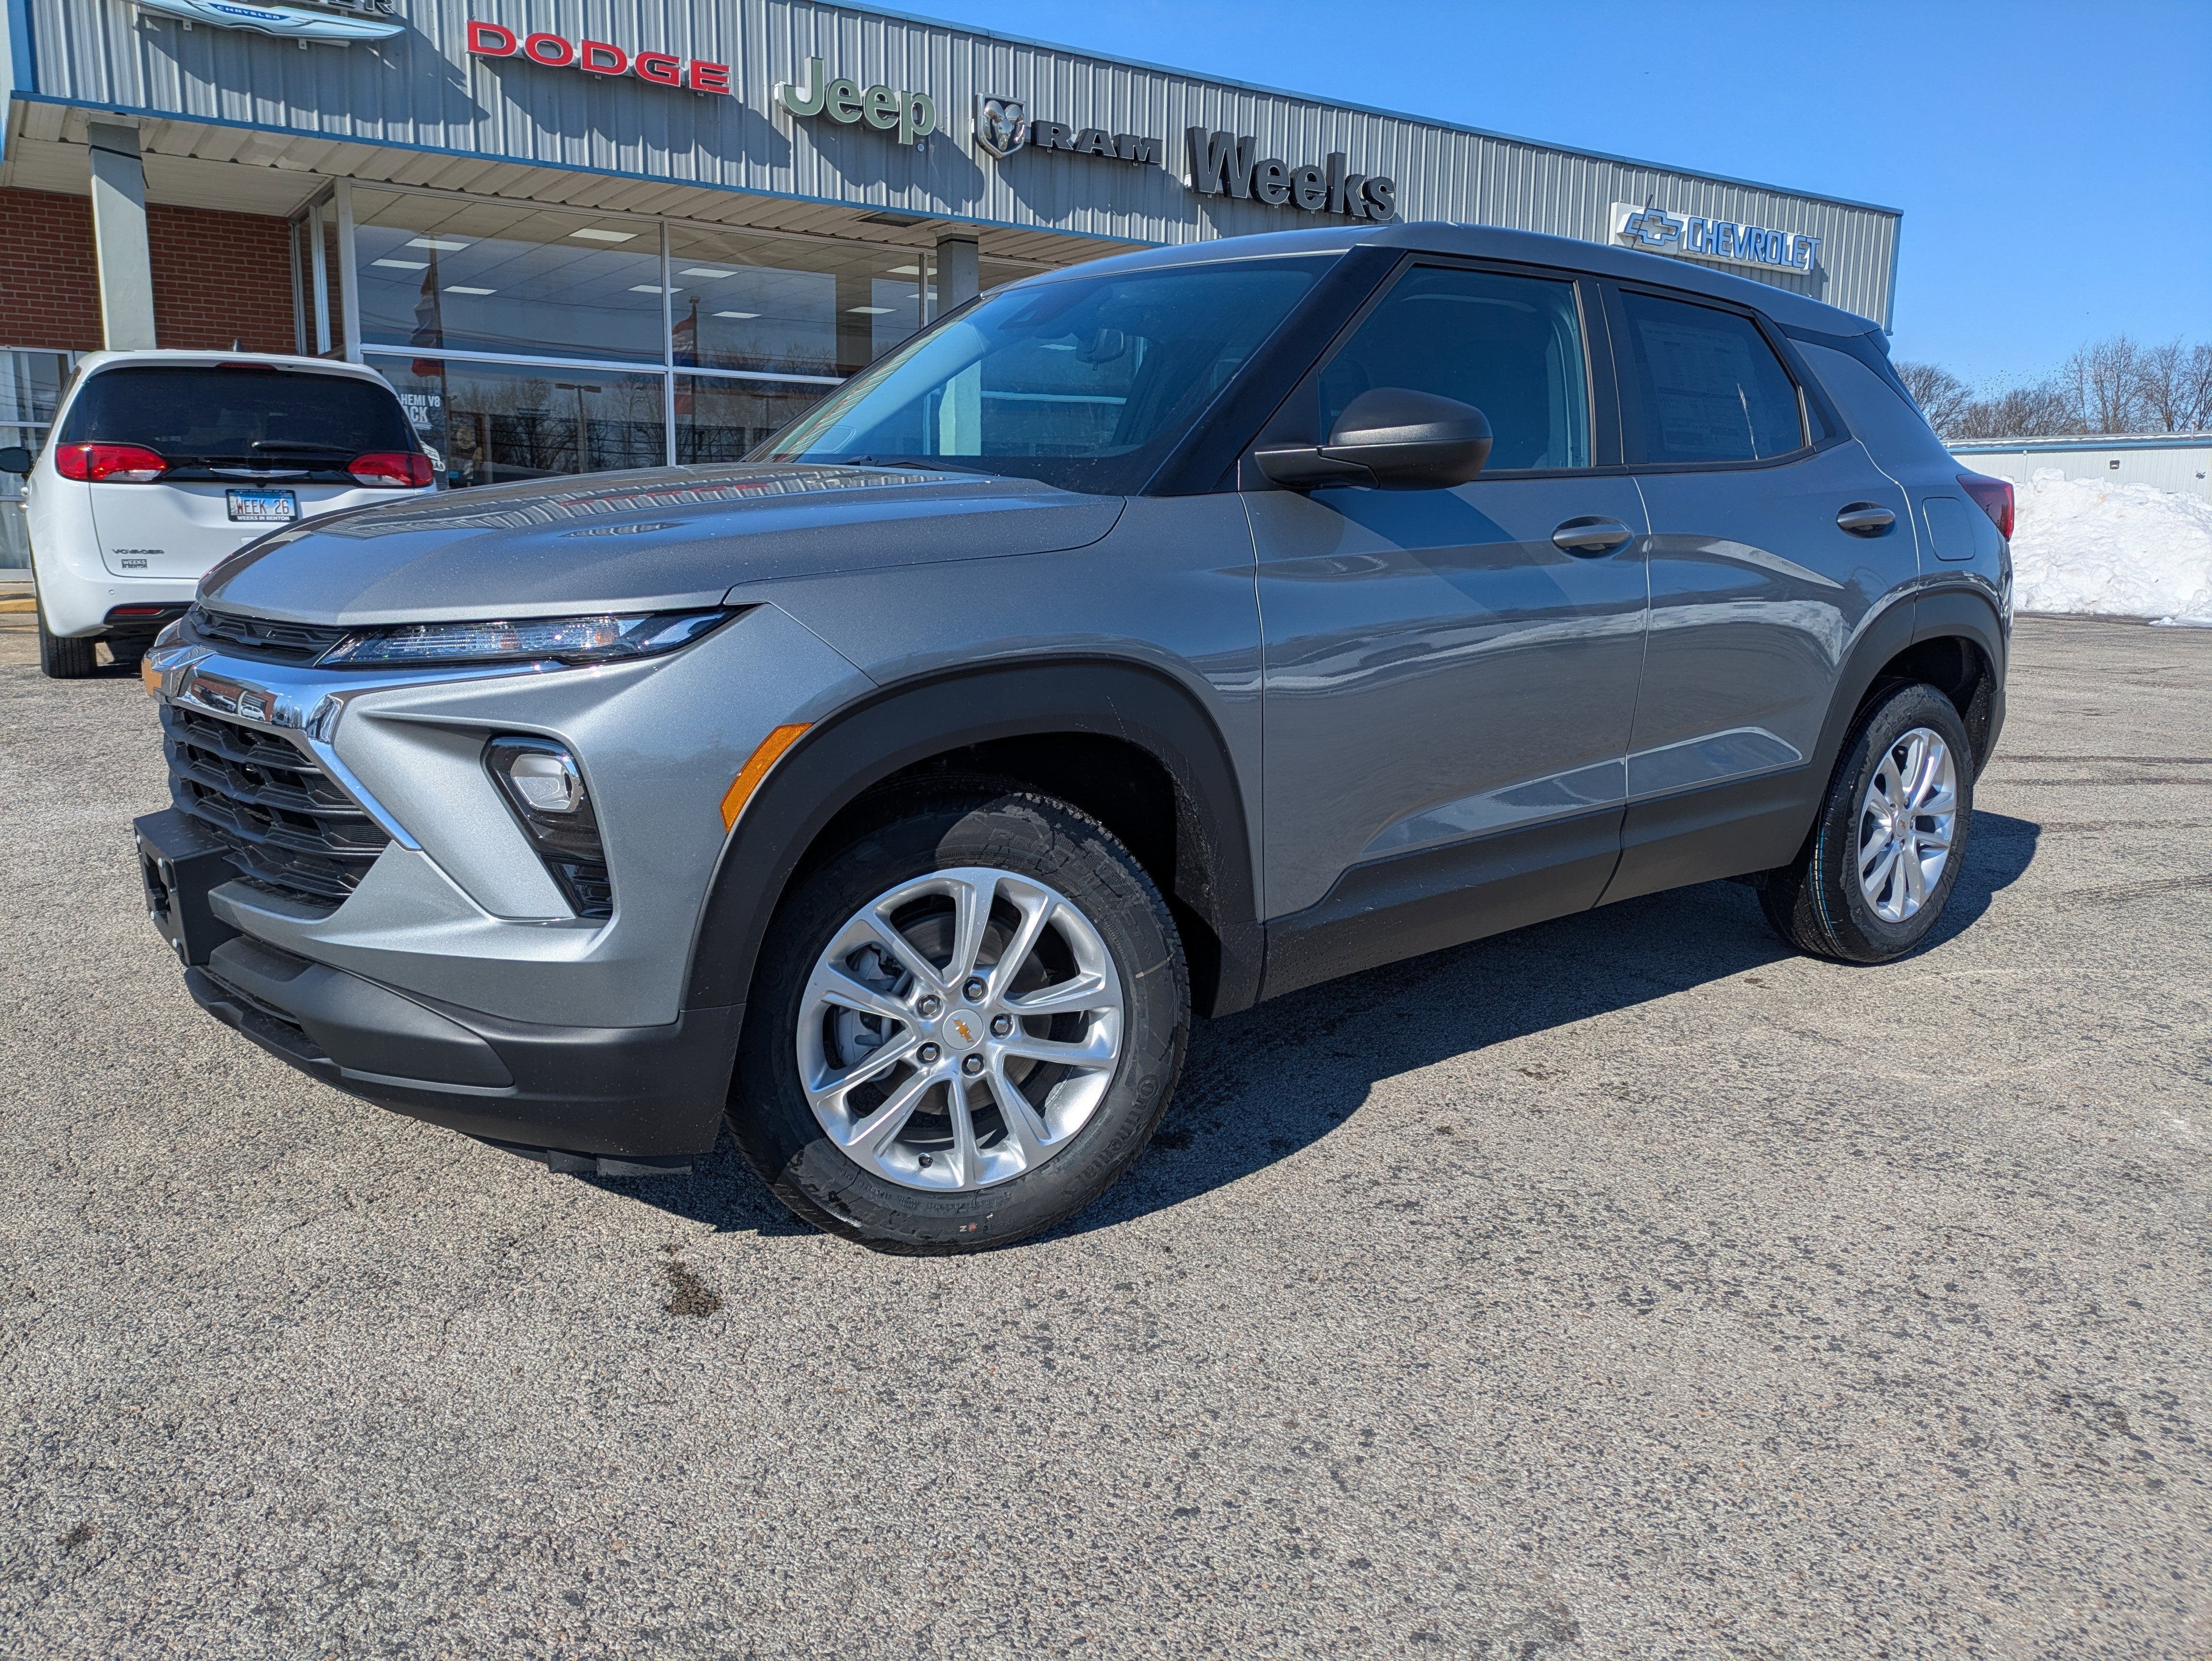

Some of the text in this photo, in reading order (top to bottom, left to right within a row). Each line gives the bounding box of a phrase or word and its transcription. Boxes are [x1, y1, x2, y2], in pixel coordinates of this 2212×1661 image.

[217, 6, 280, 20] CHRYSLER
[466, 20, 730, 95] DODGE
[776, 56, 936, 145] Jeep
[1031, 120, 1163, 165] RAM
[1186, 126, 1395, 221] Weeks
[1685, 216, 1821, 271] CHEVROLET
[401, 393, 441, 407] HEMI V8
[236, 499, 289, 514] WEEK 26
[939, 851, 966, 859] WARNING
[1075, 1074, 1161, 1183] Continental
